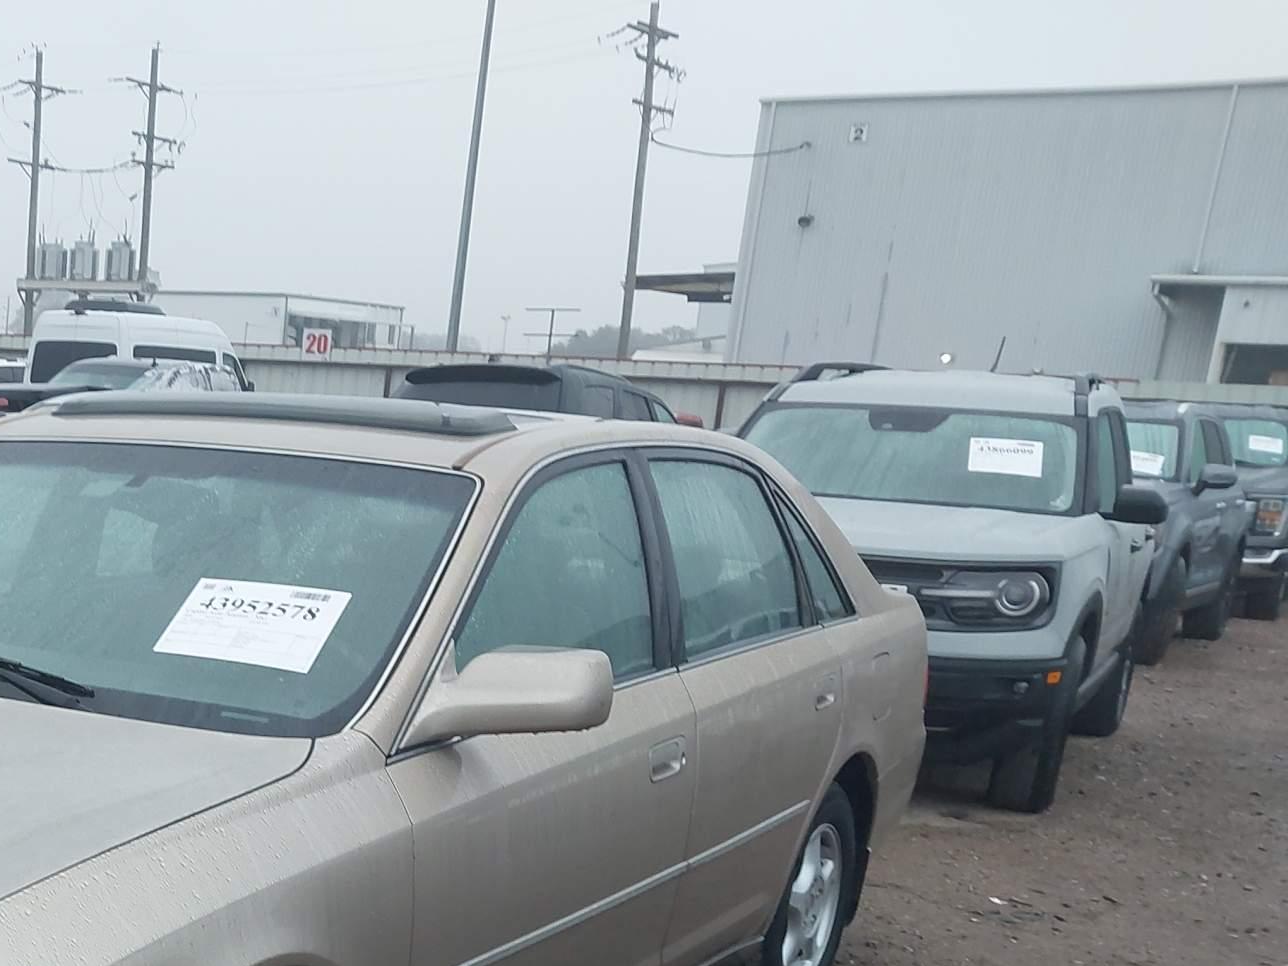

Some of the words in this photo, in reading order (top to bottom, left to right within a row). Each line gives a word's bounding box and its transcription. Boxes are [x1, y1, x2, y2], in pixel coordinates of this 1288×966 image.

[854, 128, 863, 140] 2
[305, 333, 328, 353] 20
[199, 595, 321, 621] 43952578
